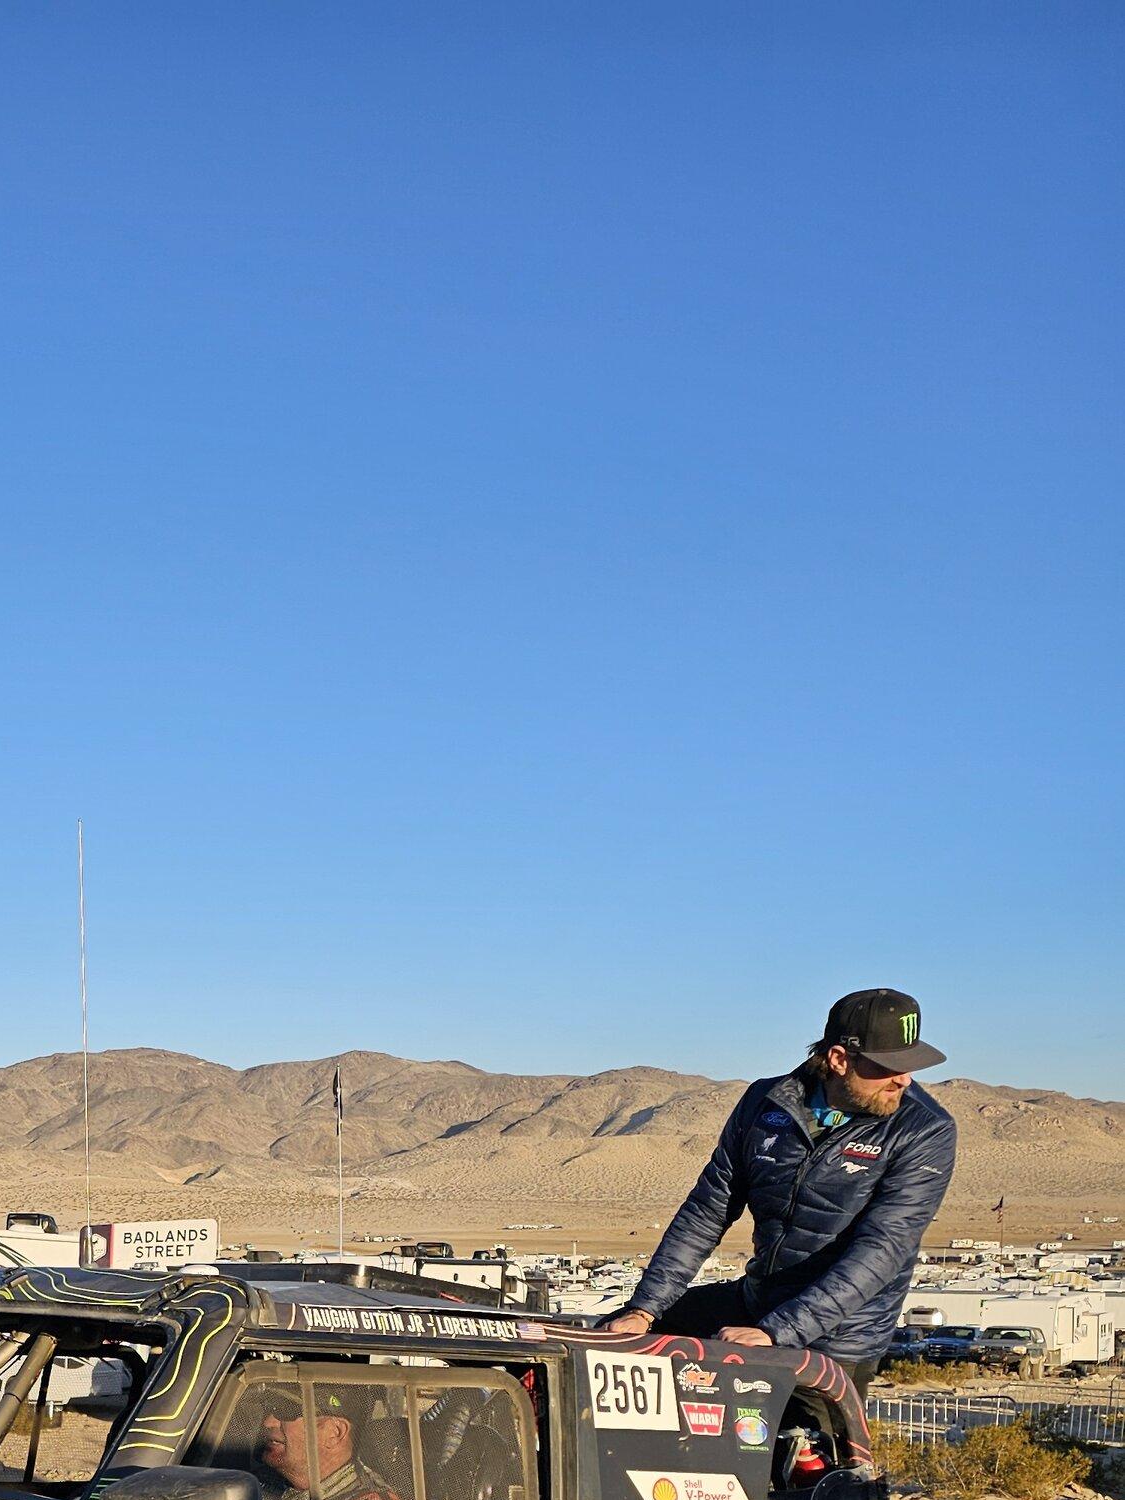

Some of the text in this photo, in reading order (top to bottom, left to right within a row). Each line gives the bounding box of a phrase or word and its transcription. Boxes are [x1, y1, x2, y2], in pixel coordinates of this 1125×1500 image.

[845, 1141, 882, 1156] FORD
[123, 1228, 208, 1244] BADLANDS
[135, 1244, 194, 1259] STREET
[302, 1307, 359, 1329] VAUGHN
[407, 1314, 425, 1333] JR
[436, 1316, 478, 1337] LOREN
[594, 1362, 662, 1415] 2567
[688, 1411, 720, 1427] WARN
[684, 1479, 703, 1489] Shell
